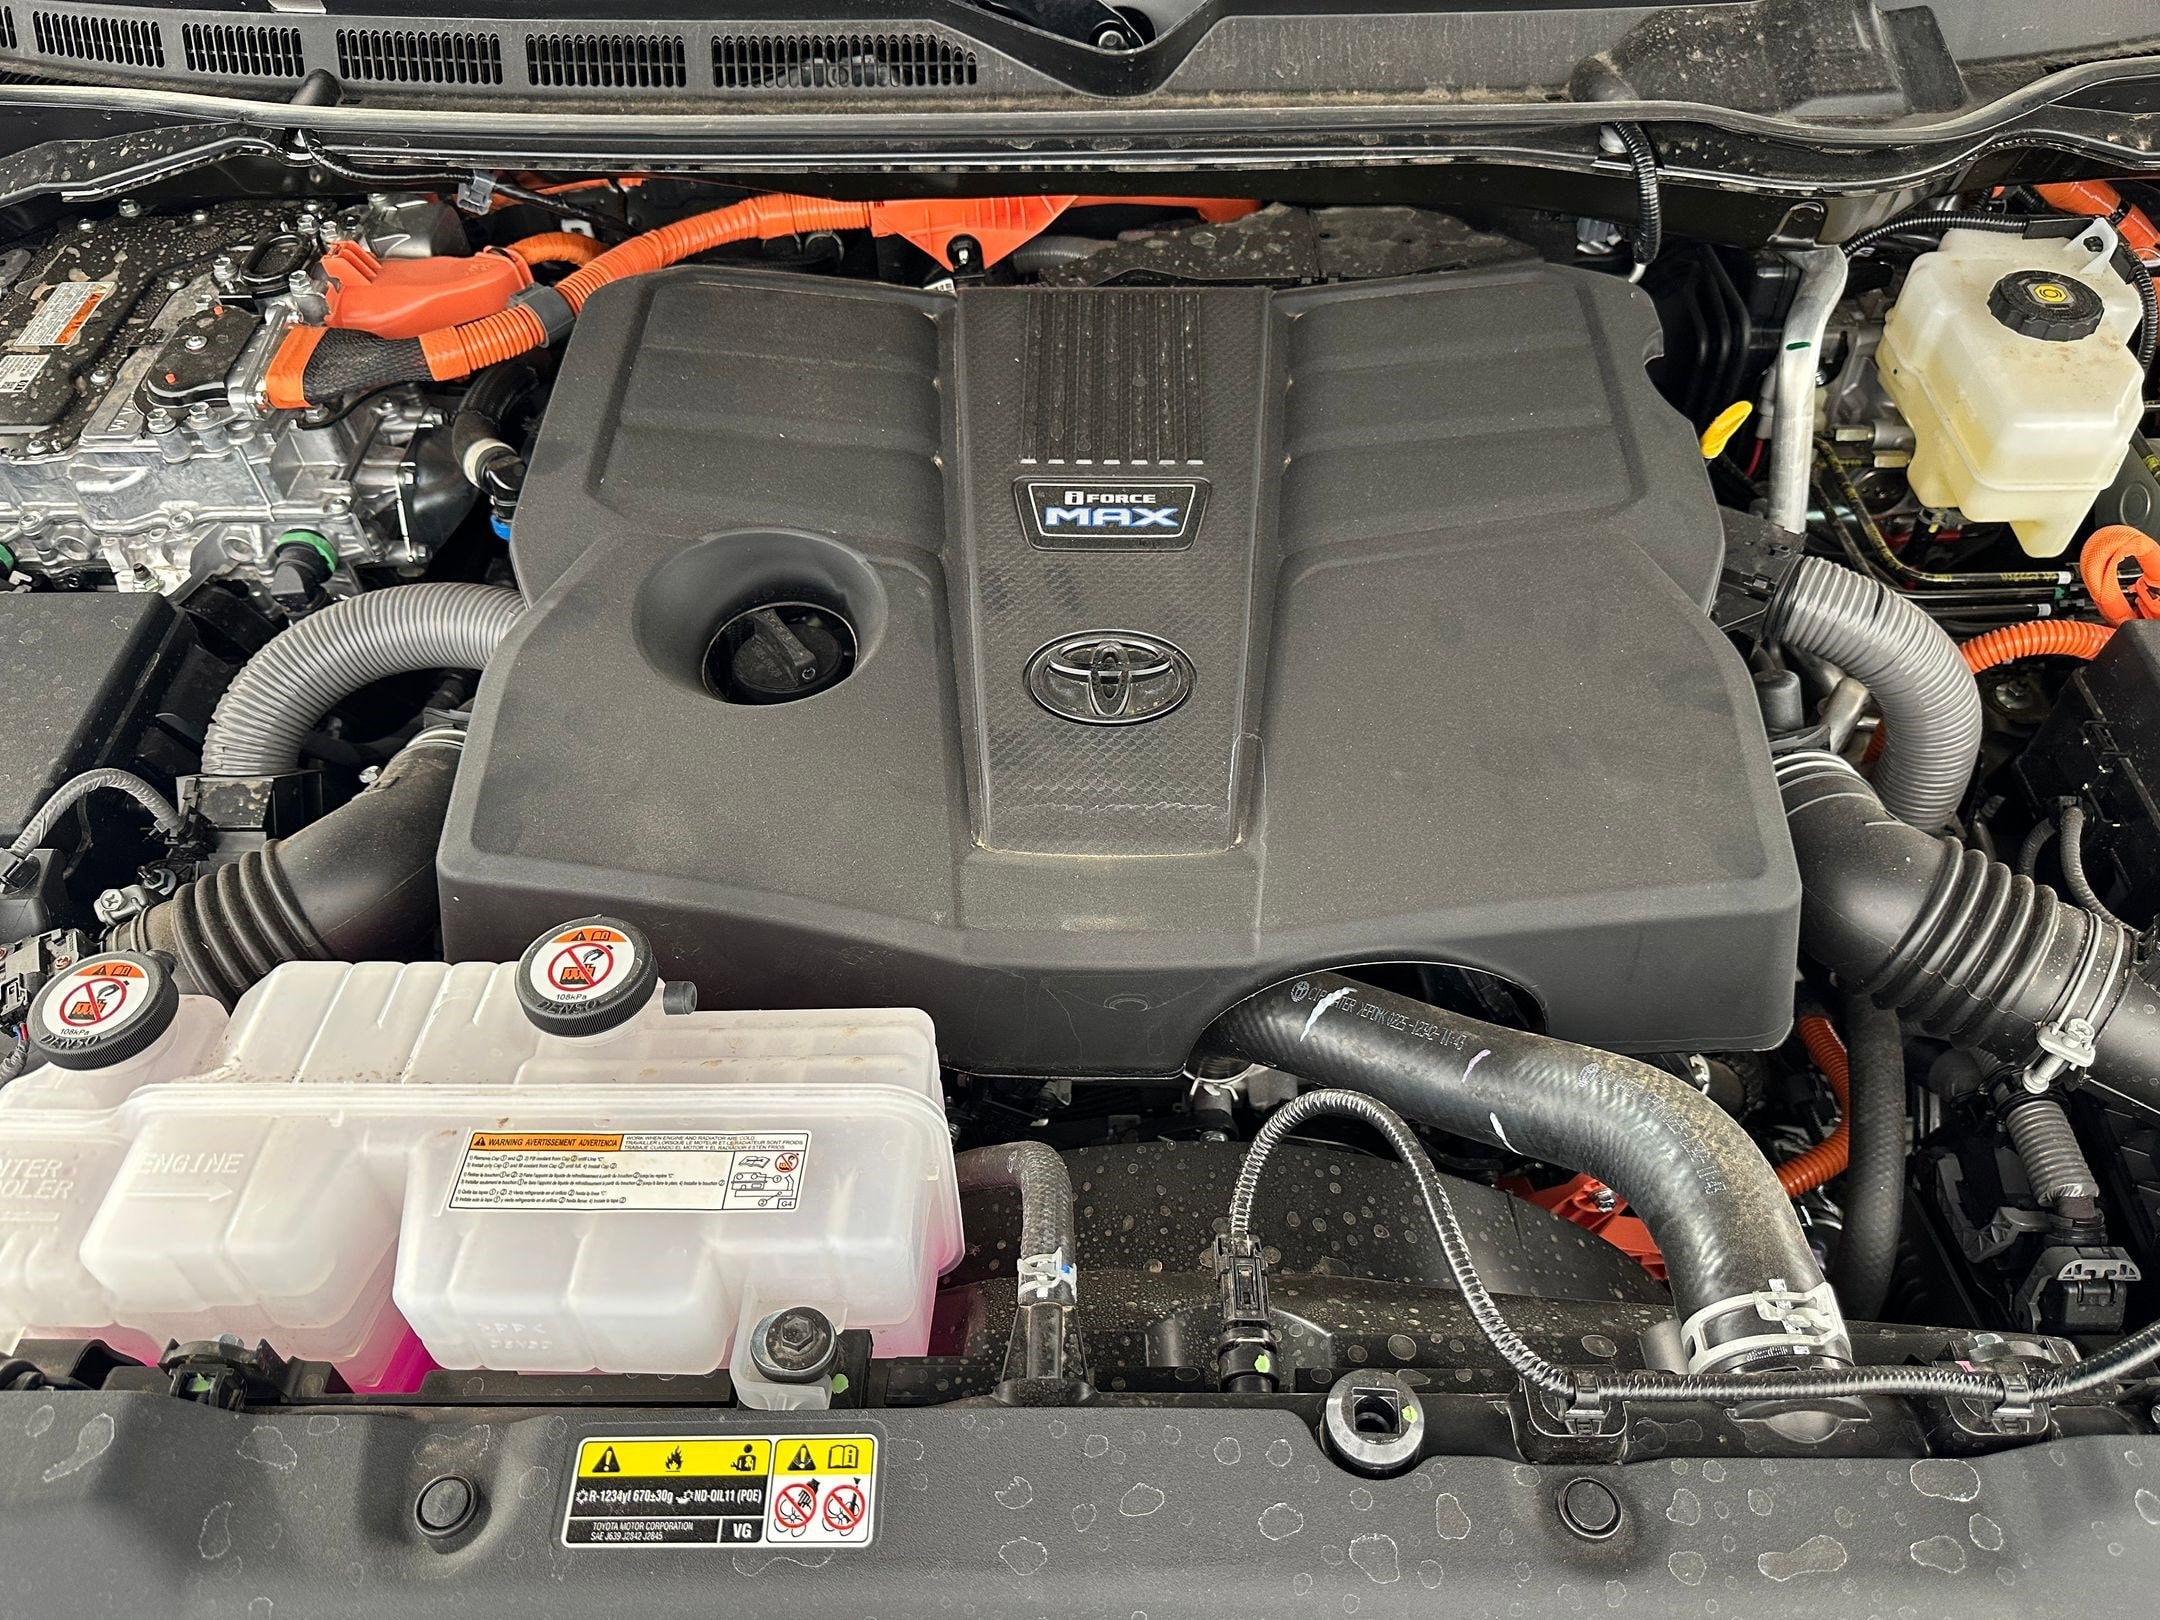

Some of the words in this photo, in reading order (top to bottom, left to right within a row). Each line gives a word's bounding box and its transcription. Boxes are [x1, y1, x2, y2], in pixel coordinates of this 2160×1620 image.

[1086, 493, 1157, 504] FORCE
[1044, 506, 1180, 528] MAX
[555, 993, 587, 1001] 108kPa
[537, 1000, 599, 1015] DENSO
[59, 1028, 90, 1036] 108kPa
[40, 1034, 101, 1050] DENSO
[488, 1138, 523, 1147] WARNING
[525, 1138, 576, 1147] AVERTISSEMENT
[578, 1139, 618, 1147] ADVERTENCIA
[136, 1152, 245, 1175] ENGINE
[0, 1179, 74, 1200] OLER
[780, 1200, 793, 1208] G4
[588, 1489, 632, 1505] R-1234yf
[632, 1489, 674, 1505] 670±30g
[694, 1489, 736, 1503] ND-OIL11
[737, 1488, 763, 1505] (POE)
[593, 1521, 619, 1531] TOYOTA
[620, 1521, 645, 1531] MOTOR
[645, 1521, 694, 1531] CORPORATION
[732, 1522, 753, 1539] VG
[590, 1531, 604, 1541] SAE
[604, 1531, 622, 1541] J639
[622, 1531, 642, 1541] J2842
[643, 1531, 664, 1541] J2845
